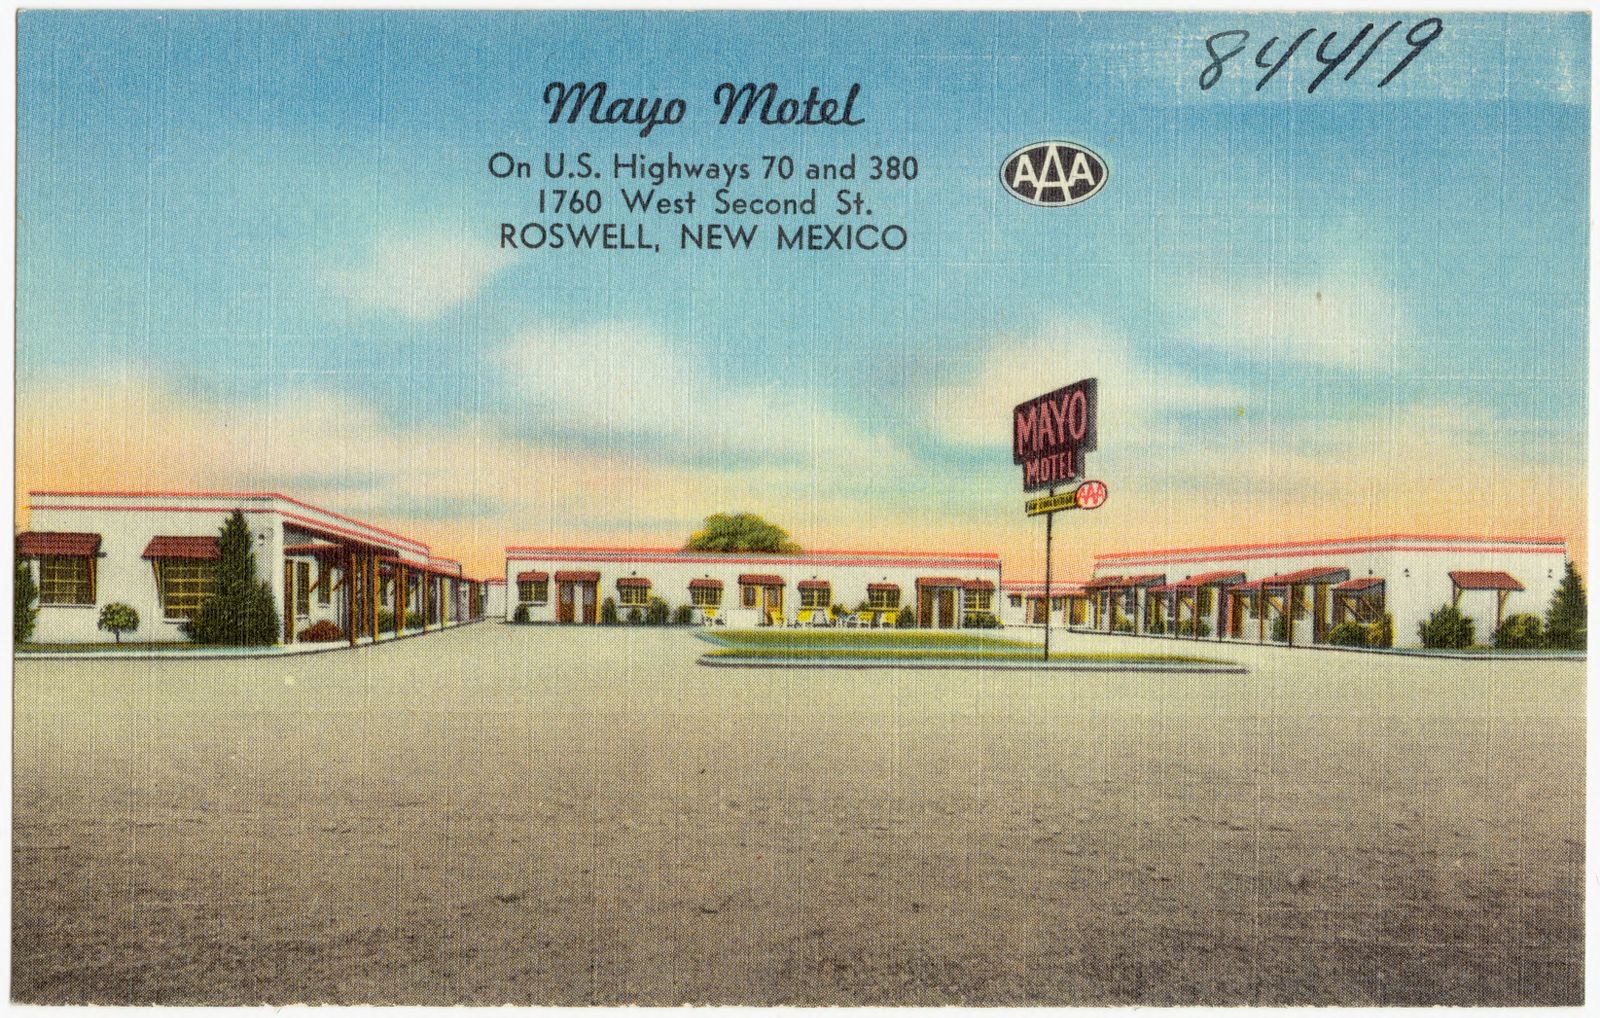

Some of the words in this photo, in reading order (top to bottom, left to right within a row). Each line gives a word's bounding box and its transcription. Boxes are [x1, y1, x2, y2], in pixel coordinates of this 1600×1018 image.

[1199, 17, 1444, 94] 84419
[1017, 389, 1088, 456] MAYO
[1025, 450, 1076, 485] MOTEL
[1078, 481, 1105, 506] AAA
